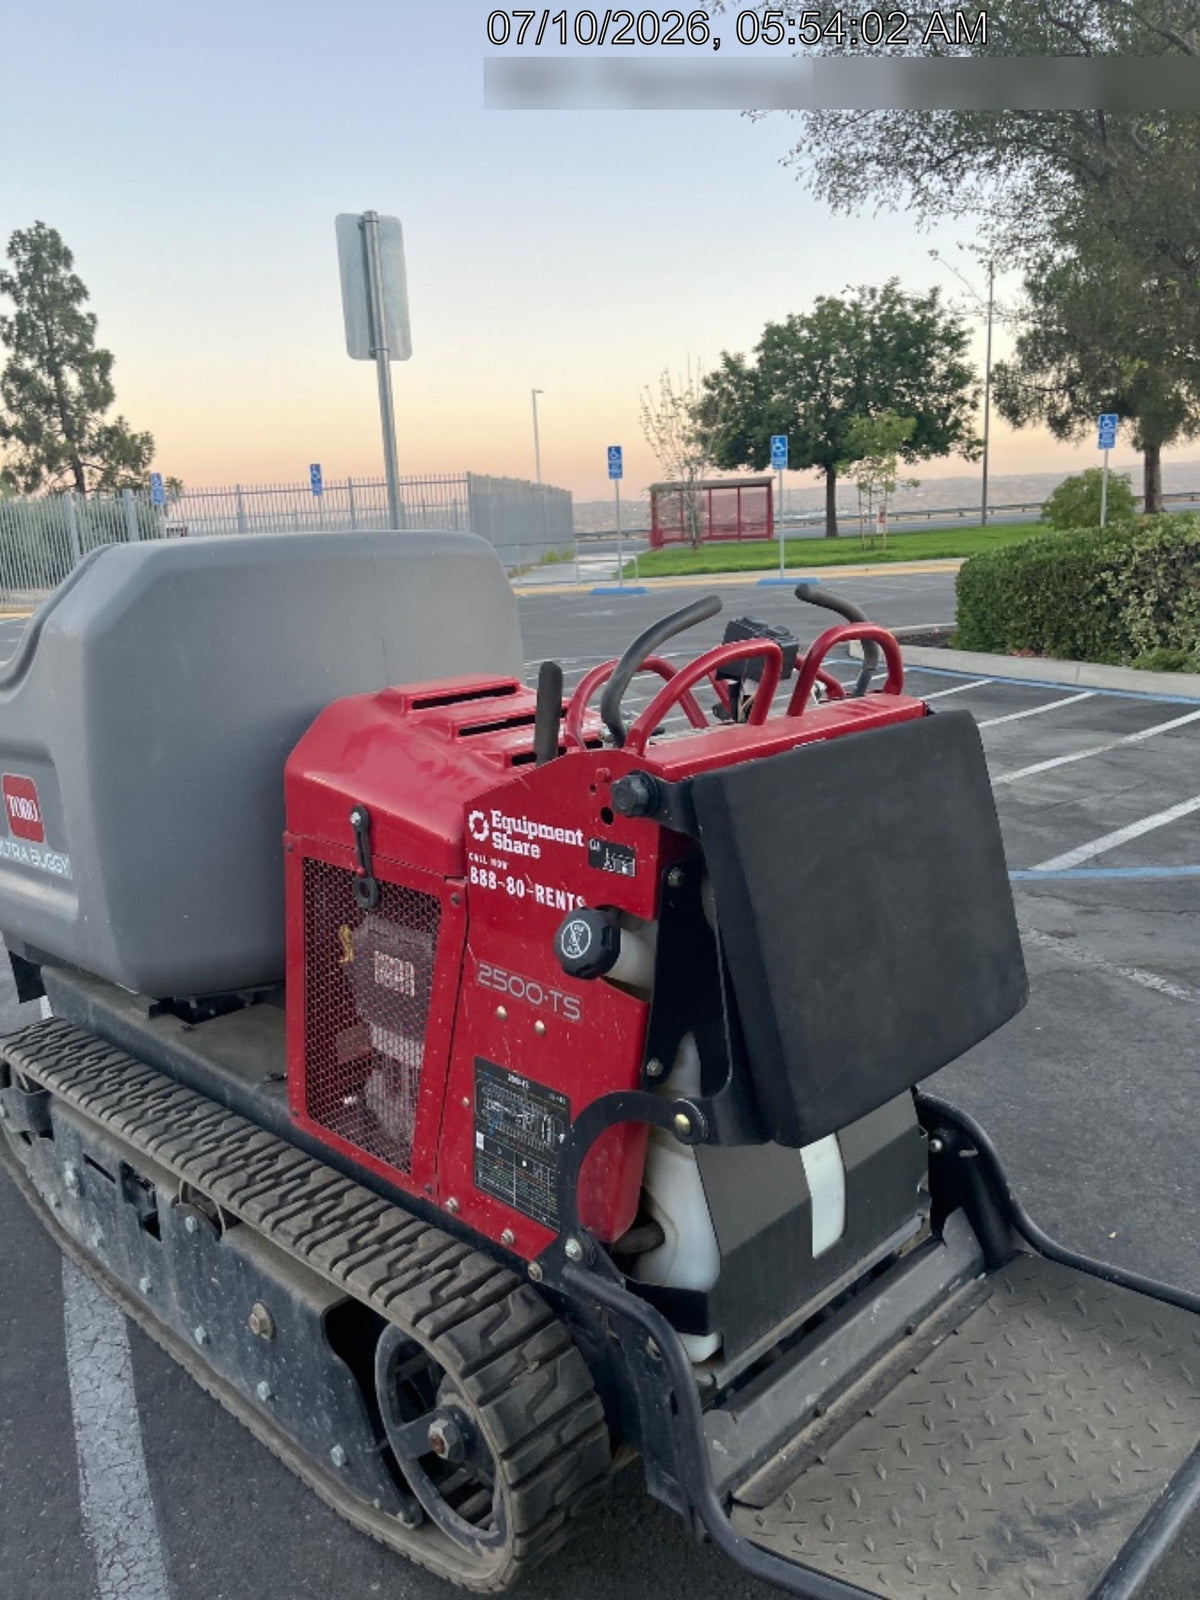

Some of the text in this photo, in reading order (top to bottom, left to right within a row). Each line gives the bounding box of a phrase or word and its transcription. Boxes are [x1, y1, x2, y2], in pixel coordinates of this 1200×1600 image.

[491, 810, 584, 847] Equipment
[491, 831, 541, 859] Share
[469, 852, 508, 870] CALL NOW
